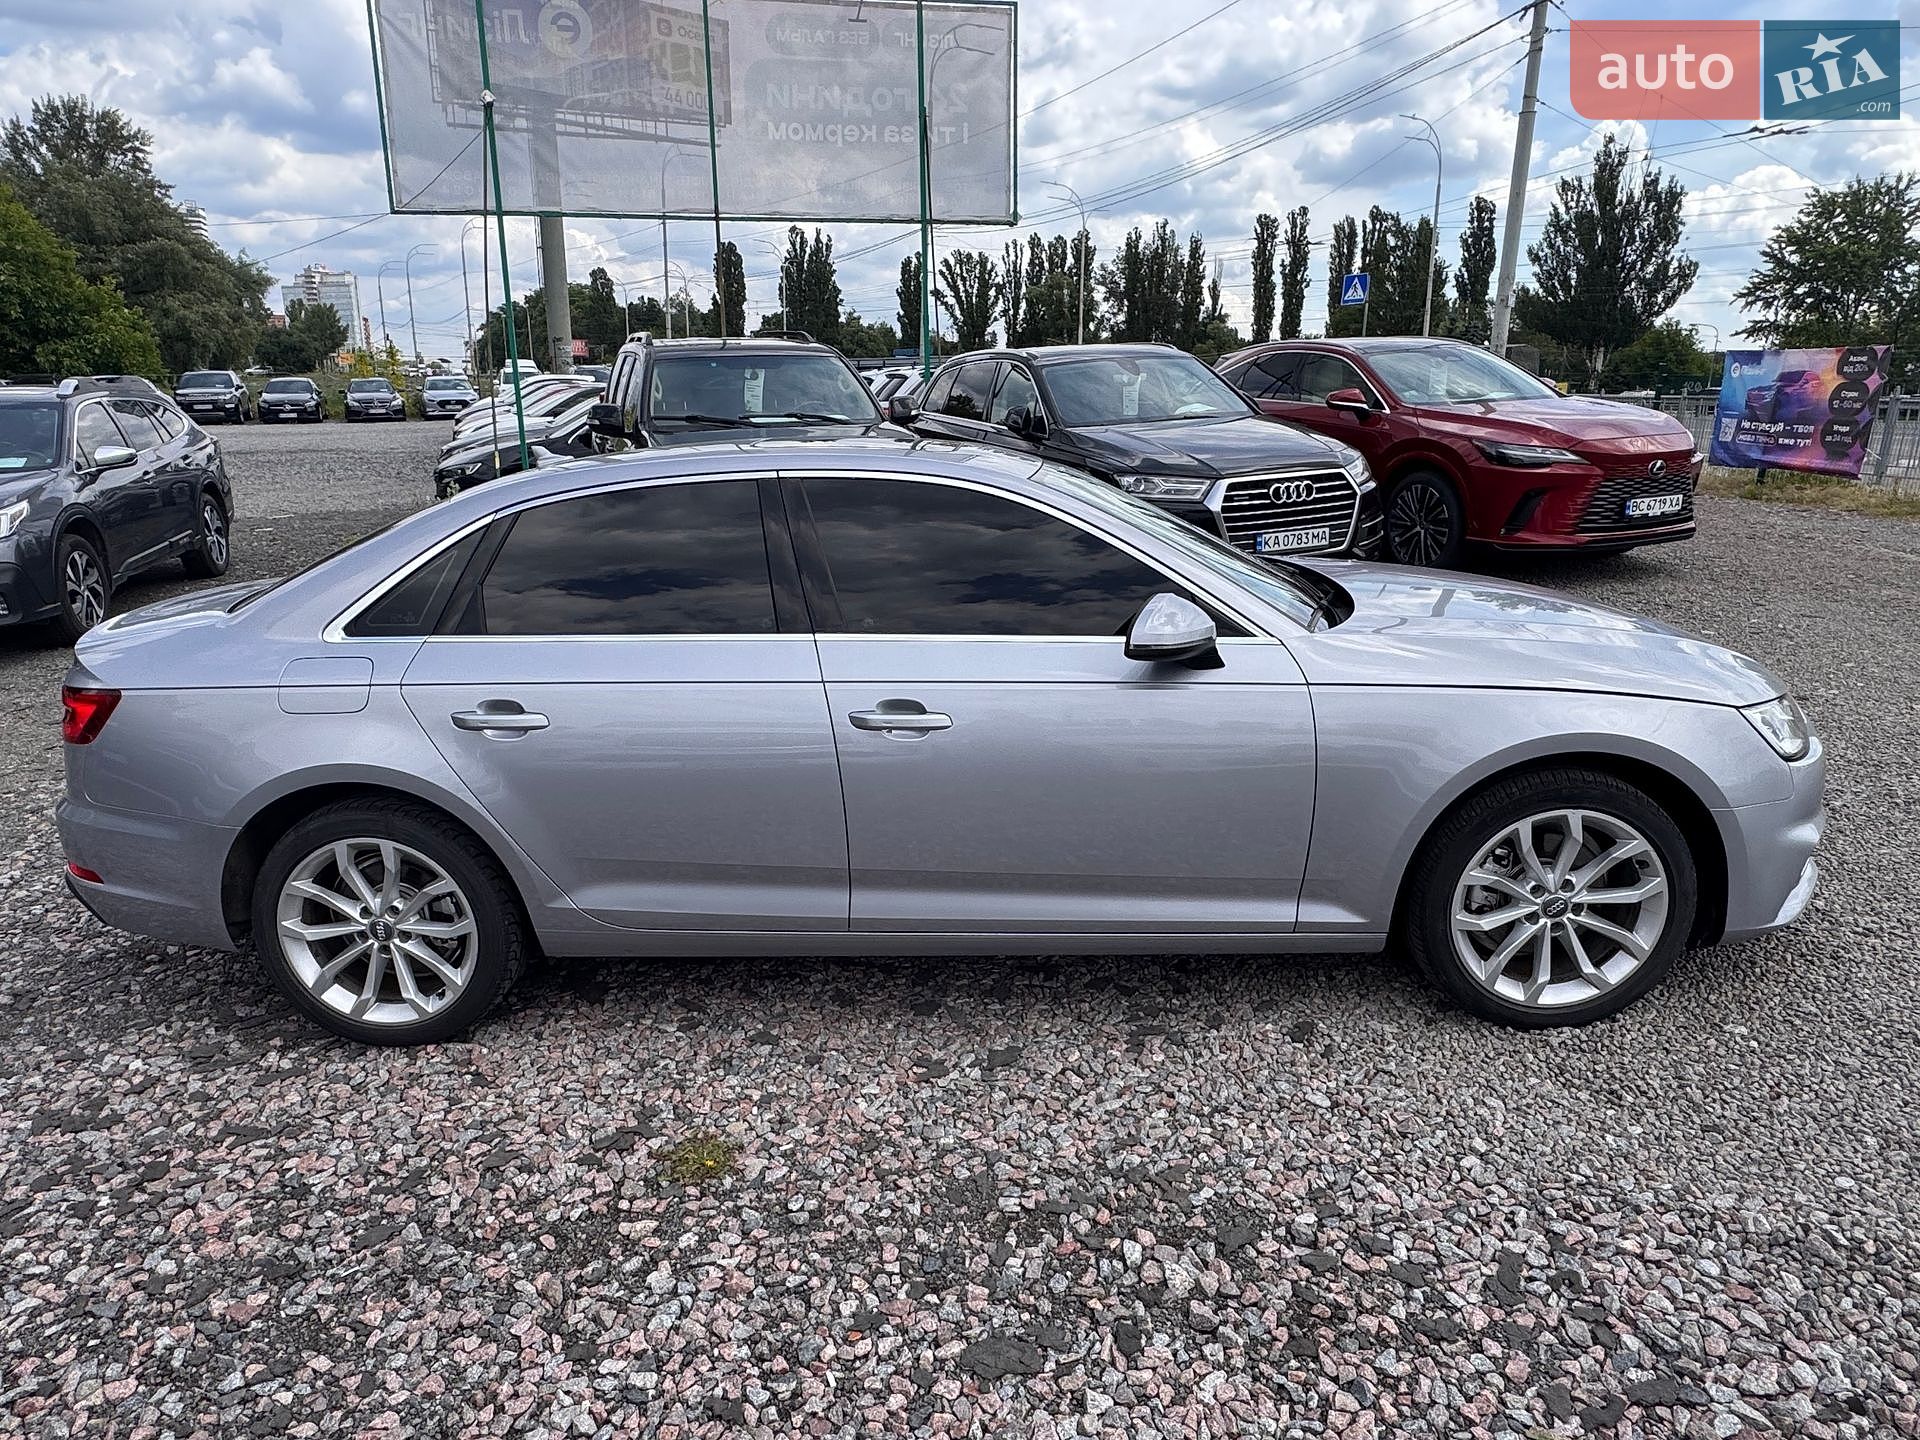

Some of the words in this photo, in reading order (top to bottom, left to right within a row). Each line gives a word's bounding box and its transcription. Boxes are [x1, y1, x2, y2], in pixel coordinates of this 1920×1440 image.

[1631, 500, 1645, 513] BC
[1646, 497, 1668, 512] 6719
[1668, 496, 1680, 509] XA
[1263, 535, 1281, 550] KA
[1282, 532, 1309, 547] 0783
[1311, 531, 1328, 544] MA
